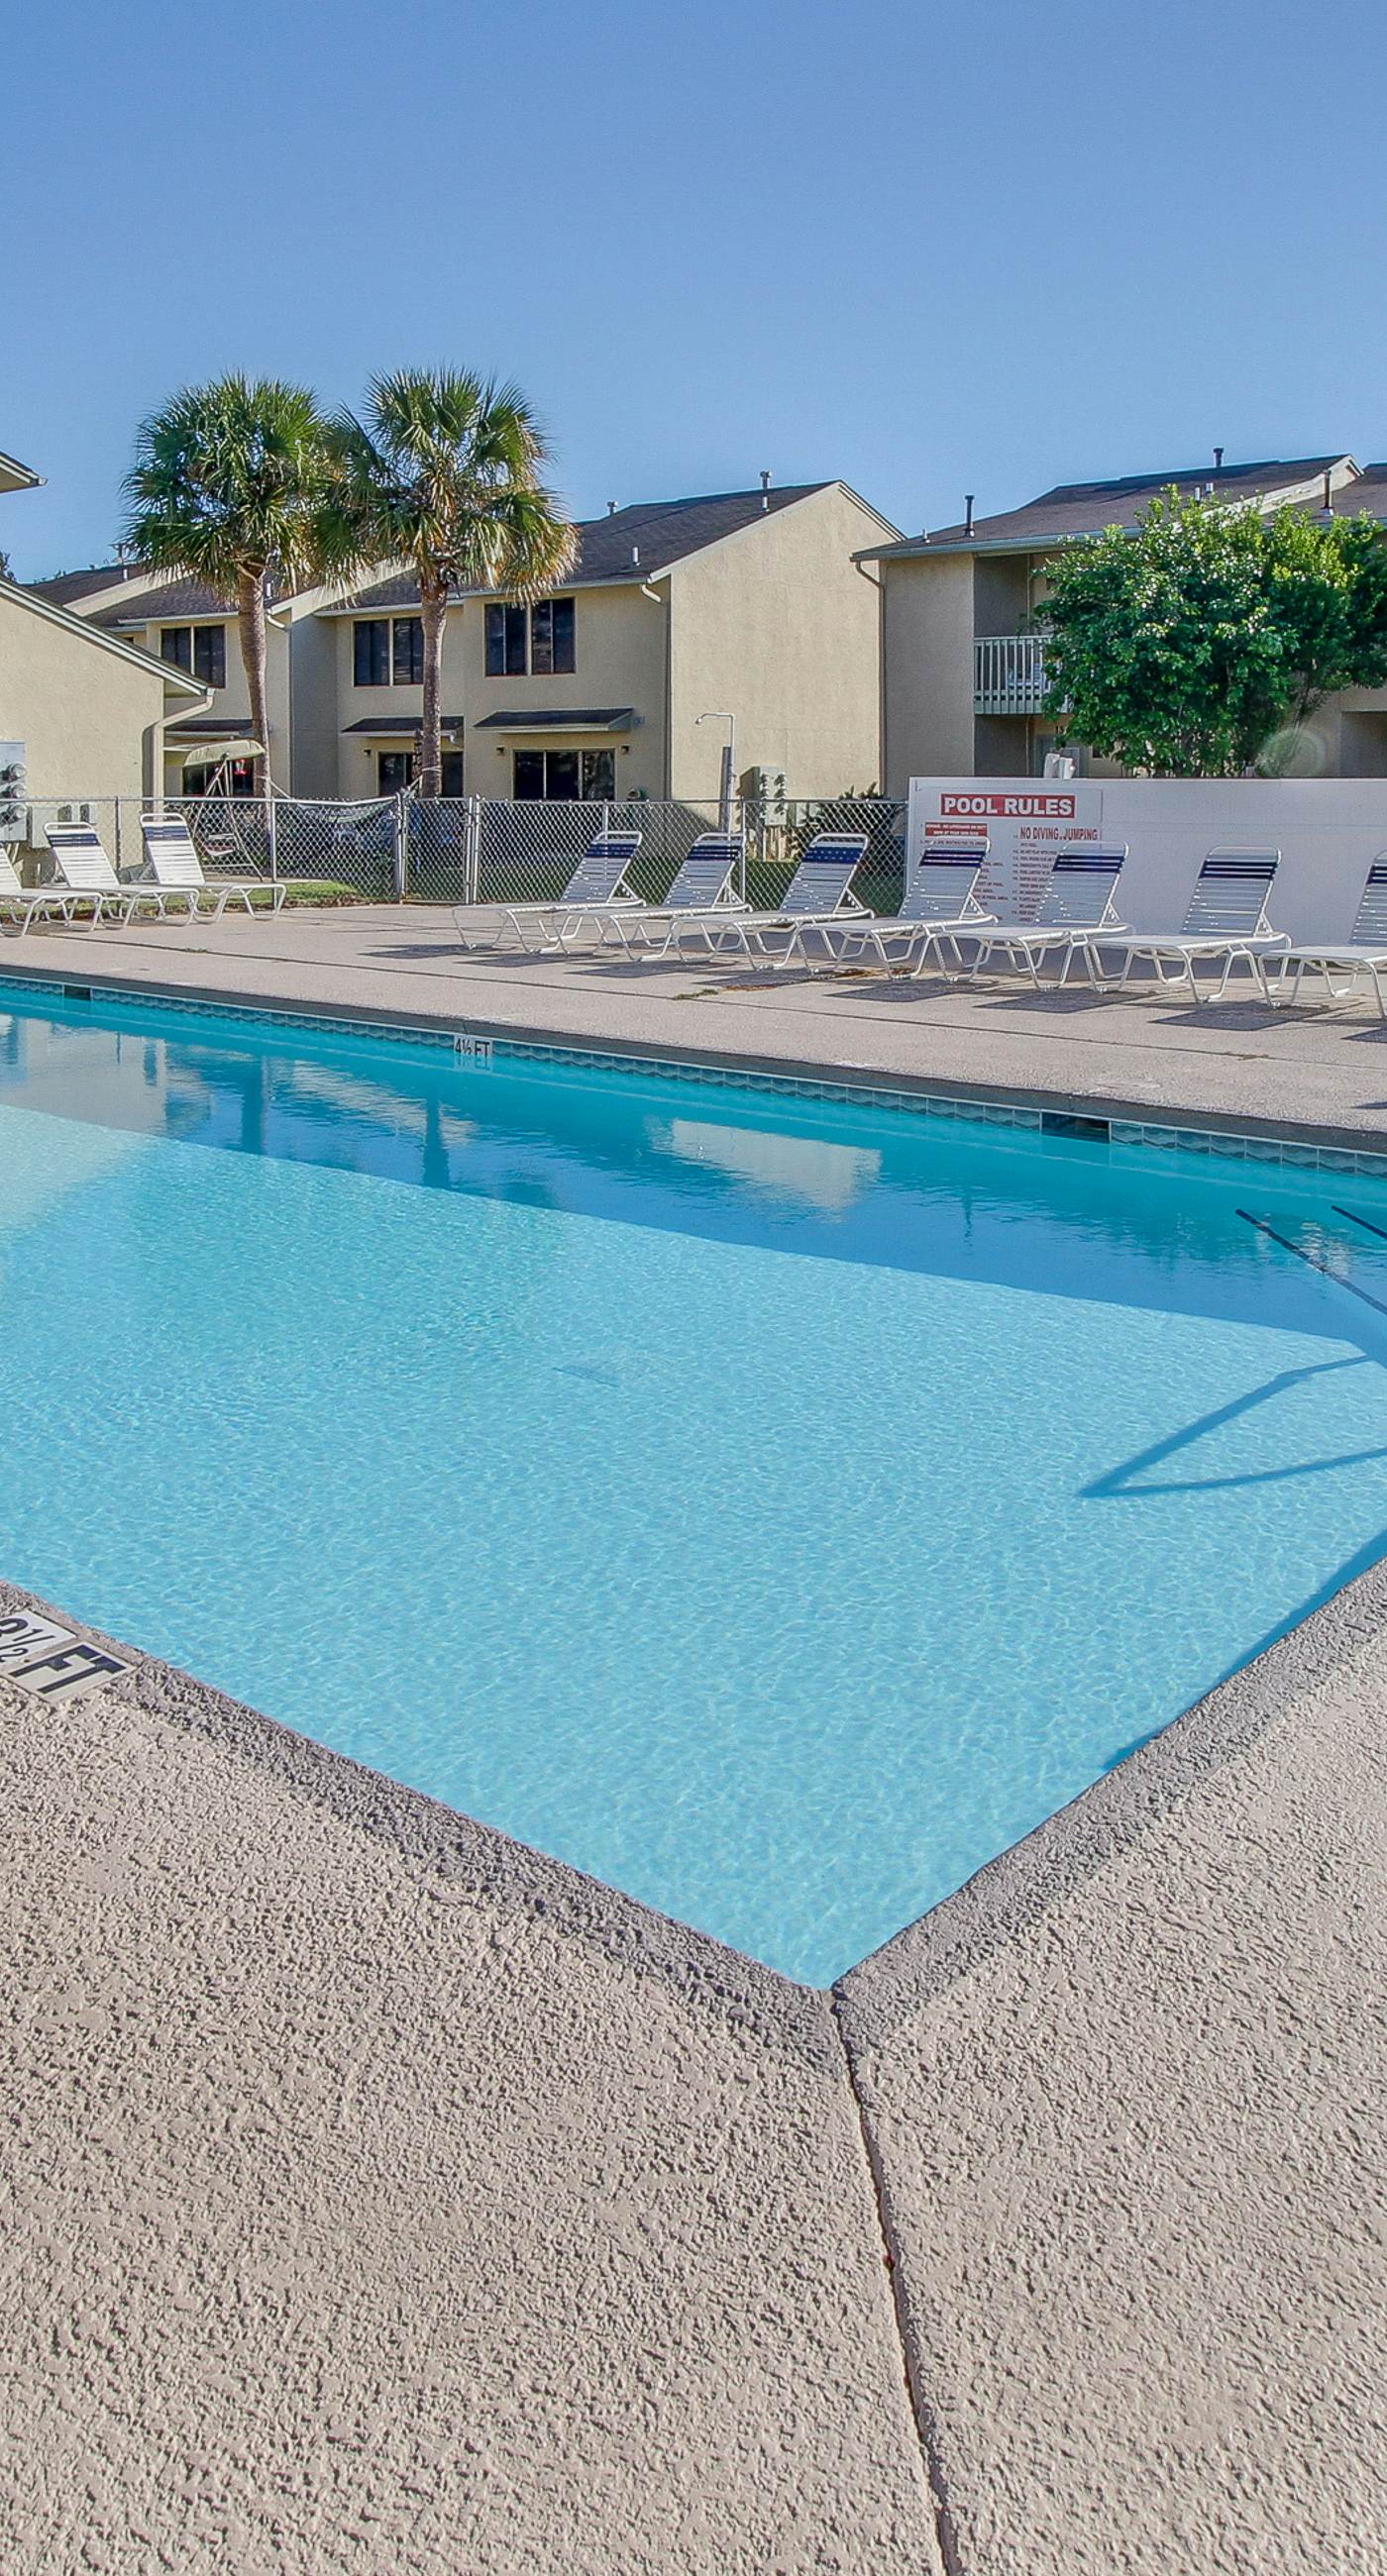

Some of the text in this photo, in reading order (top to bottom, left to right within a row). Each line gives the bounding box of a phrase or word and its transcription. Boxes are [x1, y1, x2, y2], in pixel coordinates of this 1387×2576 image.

[944, 796, 1072, 815] POOL RULES
[1020, 826, 1031, 840] NO
[1063, 828, 1098, 840] JUMPING
[475, 1040, 490, 1057] FT
[8, 1644, 127, 1694] FT
